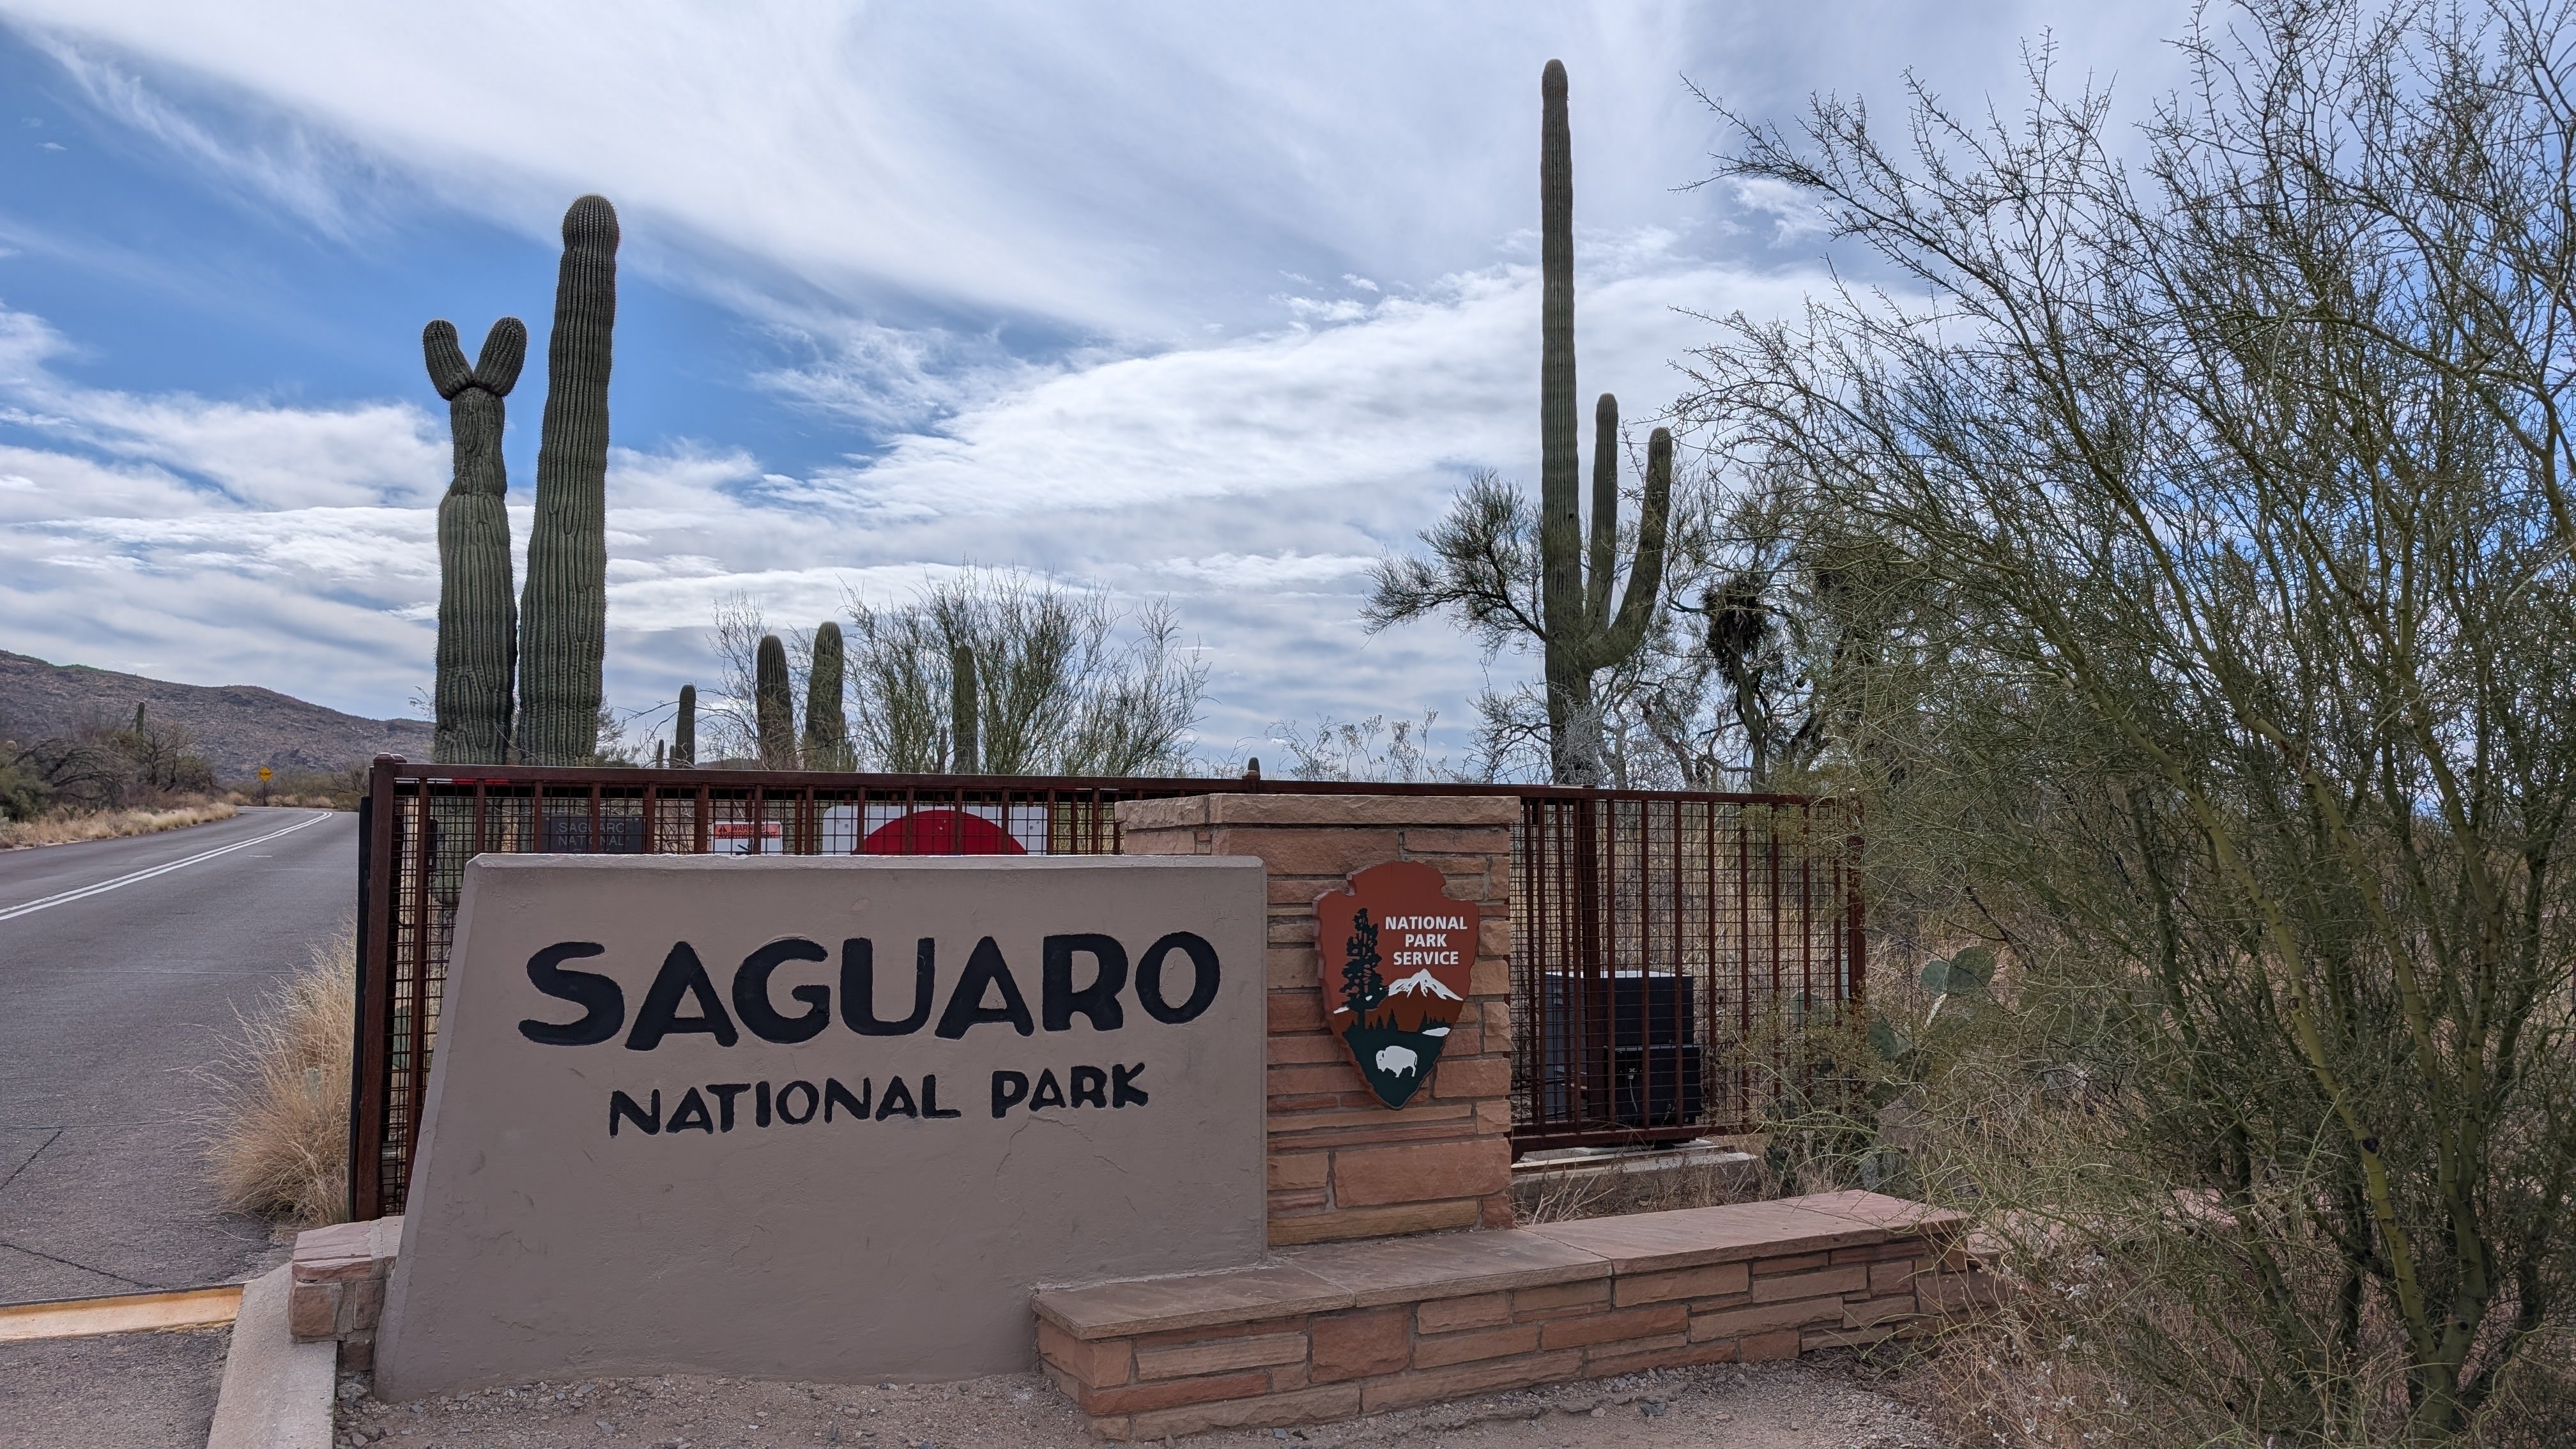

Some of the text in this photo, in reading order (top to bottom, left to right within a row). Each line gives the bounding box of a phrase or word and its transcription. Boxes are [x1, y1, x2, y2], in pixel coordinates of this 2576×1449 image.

[1385, 916, 1468, 930] NATIONAL
[1405, 933, 1447, 947] PARK
[1393, 951, 1459, 965] SERVICE
[518, 931, 1221, 1052] SAGUARO
[610, 1062, 1149, 1139] NATIONAL PARK
